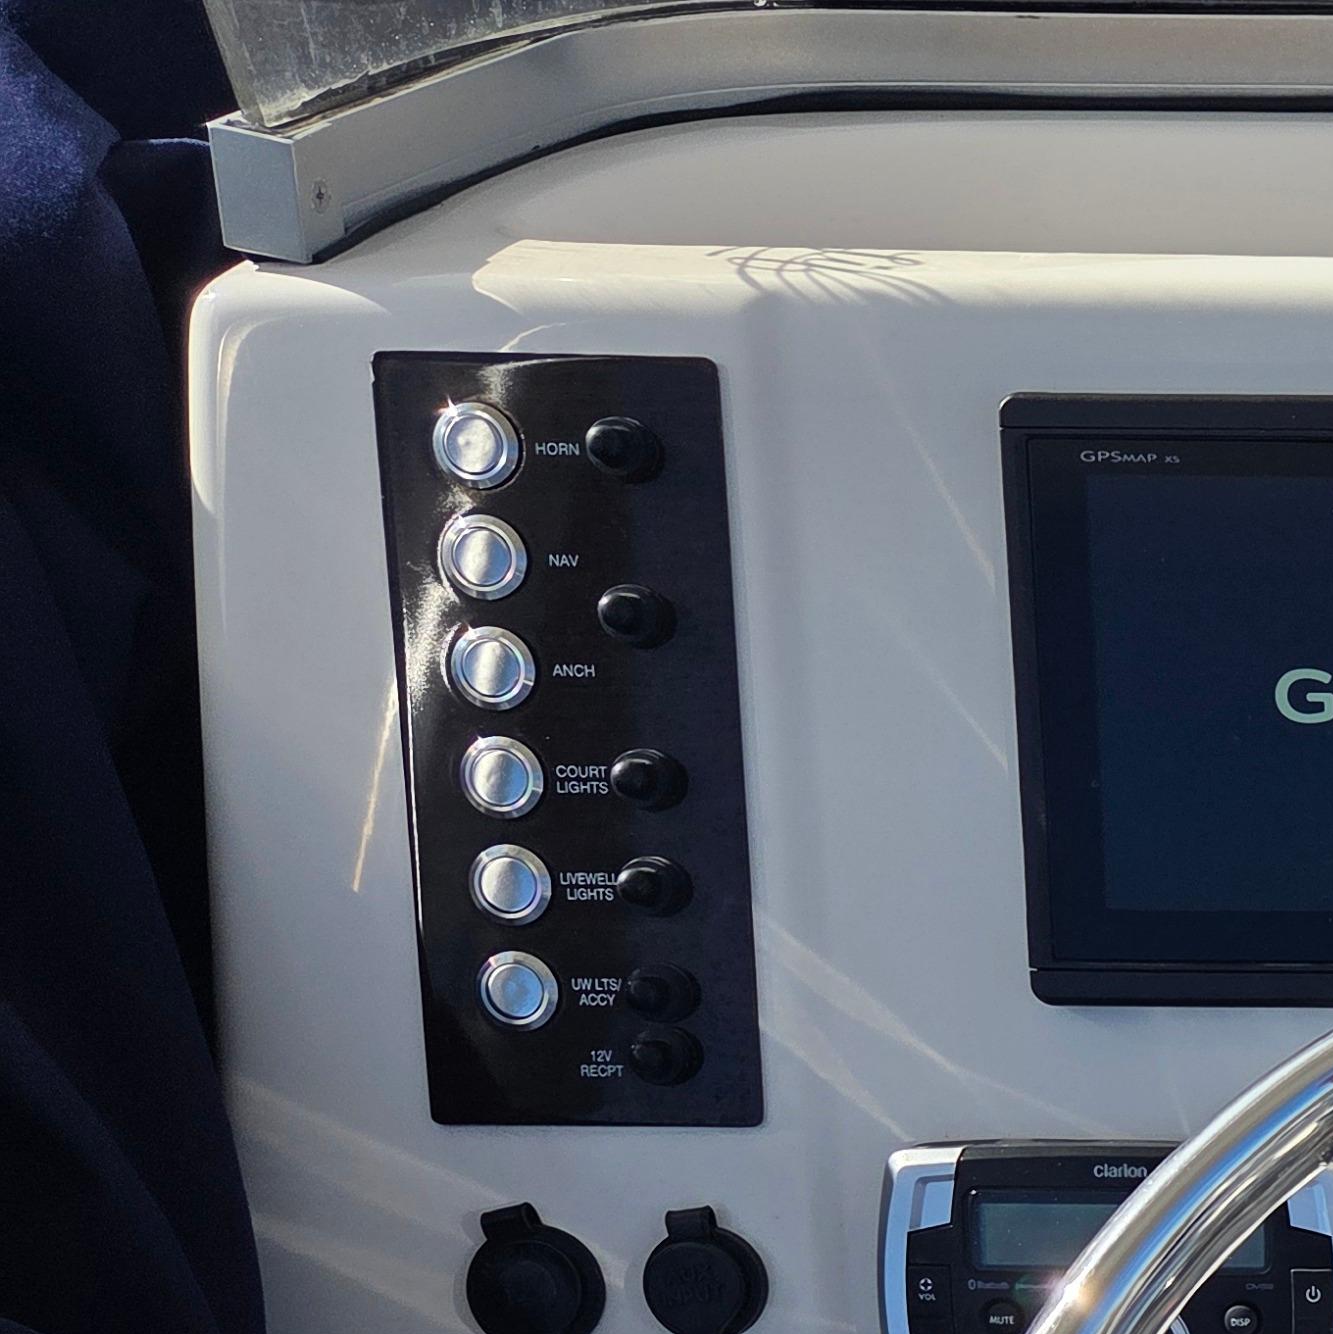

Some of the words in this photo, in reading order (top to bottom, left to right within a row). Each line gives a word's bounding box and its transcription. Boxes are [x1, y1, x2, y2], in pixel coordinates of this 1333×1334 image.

[535, 442, 580, 456] HORN
[548, 554, 579, 567] NAV
[552, 664, 596, 678] ANCH
[556, 765, 607, 778] COURT
[556, 781, 609, 794] LIGHTS
[560, 873, 618, 885] LIVEWELL
[567, 888, 614, 901] LIGHTS
[571, 979, 592, 992] UW
[594, 979, 622, 992] LTS/
[579, 994, 615, 1006] ACCY
[591, 1051, 612, 1062] 12V
[580, 1065, 624, 1077] RECPT
[918, 1293, 936, 1301] VOL
[989, 1315, 1015, 1325] MUTE
[1230, 1318, 1251, 1327] DISP
